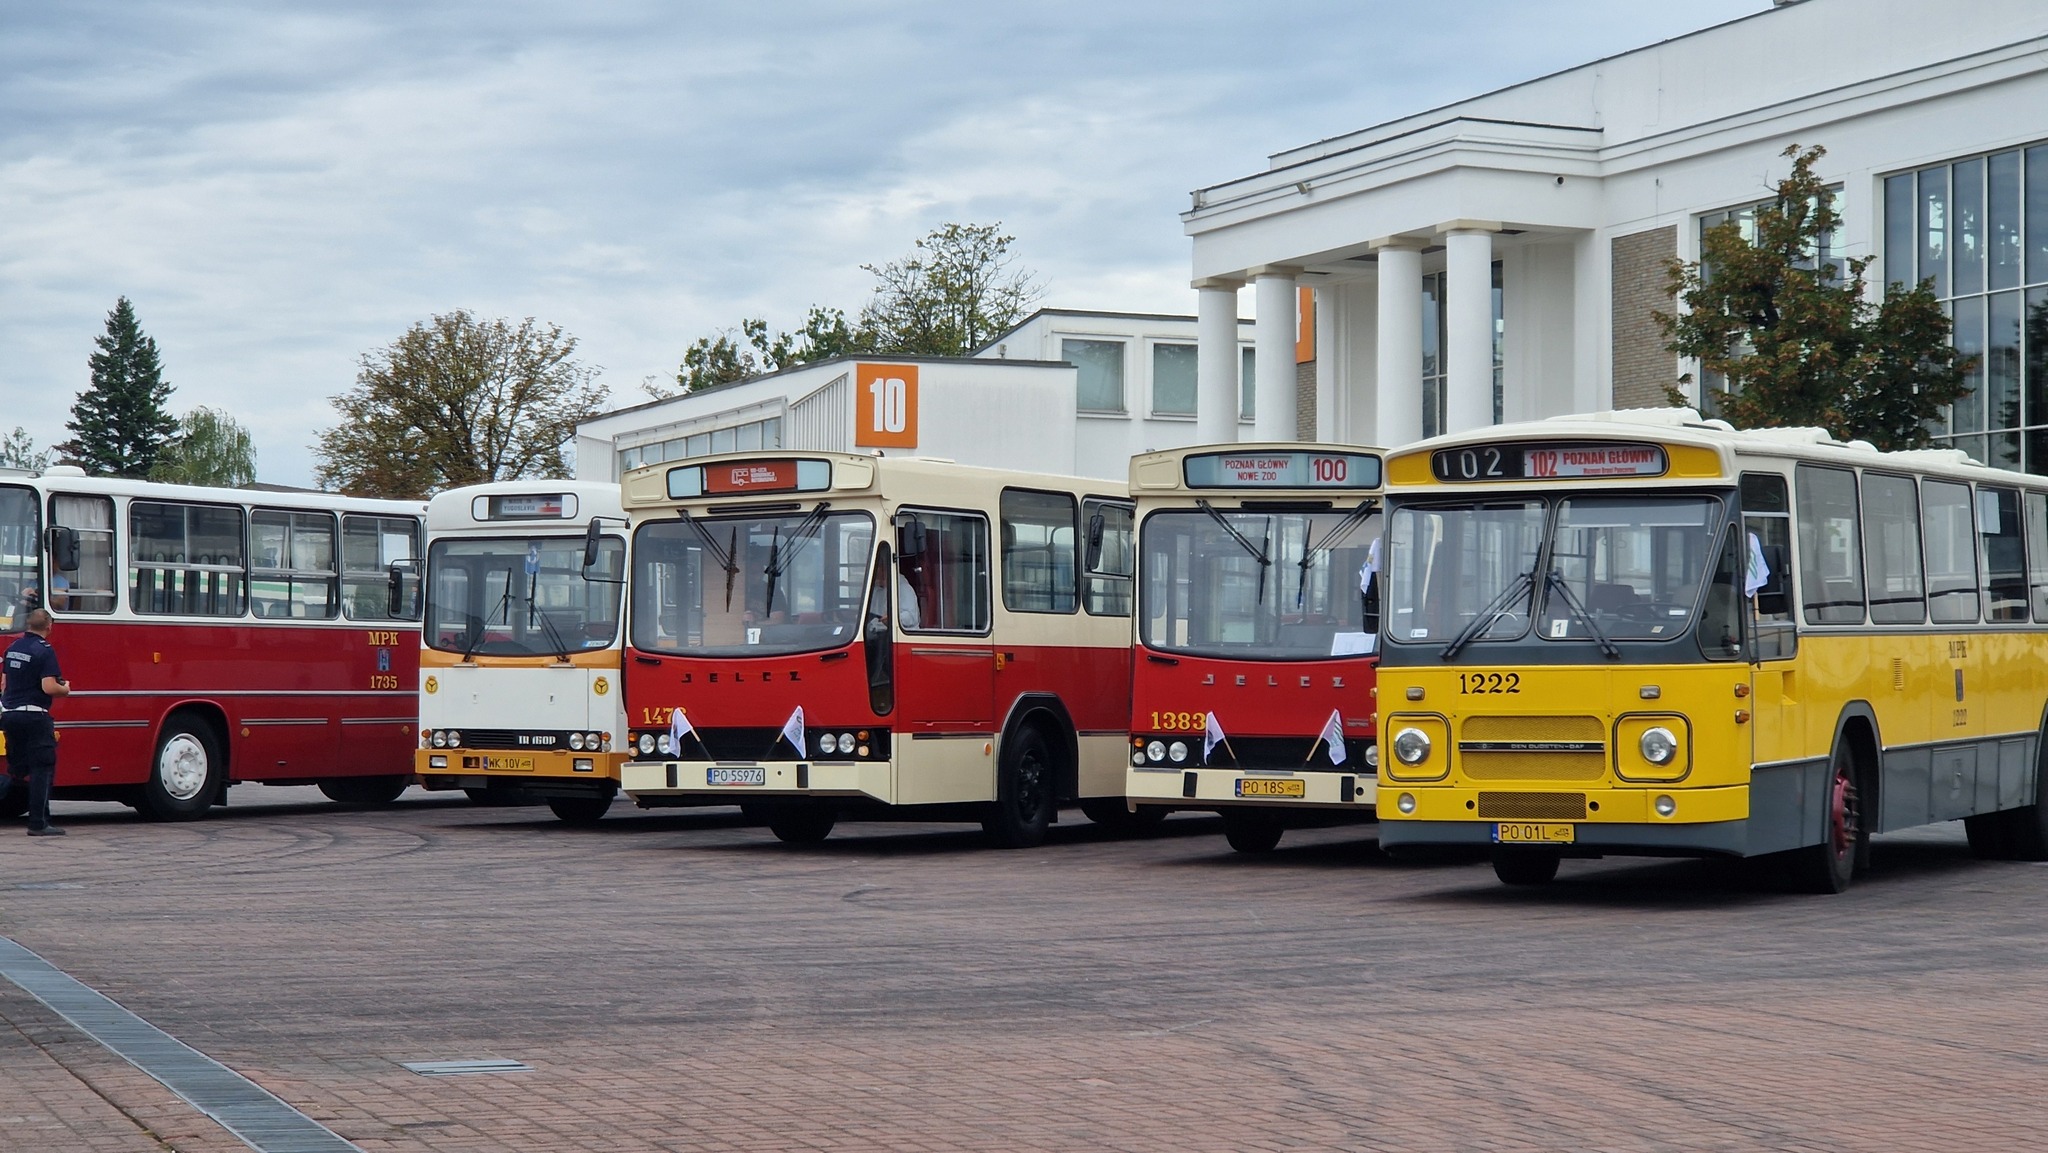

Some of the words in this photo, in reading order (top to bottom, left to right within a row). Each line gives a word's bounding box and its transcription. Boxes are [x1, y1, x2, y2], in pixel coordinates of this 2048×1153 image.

[870, 378, 906, 433] 10
[1225, 458, 1255, 469] POZNAŃ
[1258, 458, 1289, 469] GŁÓWNY
[1439, 447, 1503, 479] 102
[1530, 451, 1558, 477] 102
[1562, 450, 1607, 466] POZNAŃ
[1608, 448, 1656, 465] GŁÓWNY
[1237, 472, 1259, 481] NOWE
[1262, 472, 1277, 481] ZOO
[1313, 458, 1347, 482] 100
[368, 631, 399, 646] MPK
[1948, 640, 1968, 659] MPK
[370, 675, 398, 689] 1735
[681, 671, 802, 684] JELCZ
[1201, 673, 1345, 688] JELCZ
[1459, 672, 1521, 695] 1222
[643, 706, 687, 725] 147
[1151, 711, 1207, 731] 1383
[489, 758, 501, 769] WK
[505, 758, 521, 769] 10V
[713, 770, 728, 782] PO
[1243, 781, 1259, 794] PO
[1264, 781, 1285, 794] 18S
[1501, 824, 1519, 840] PO
[1524, 825, 1551, 840] 01L
